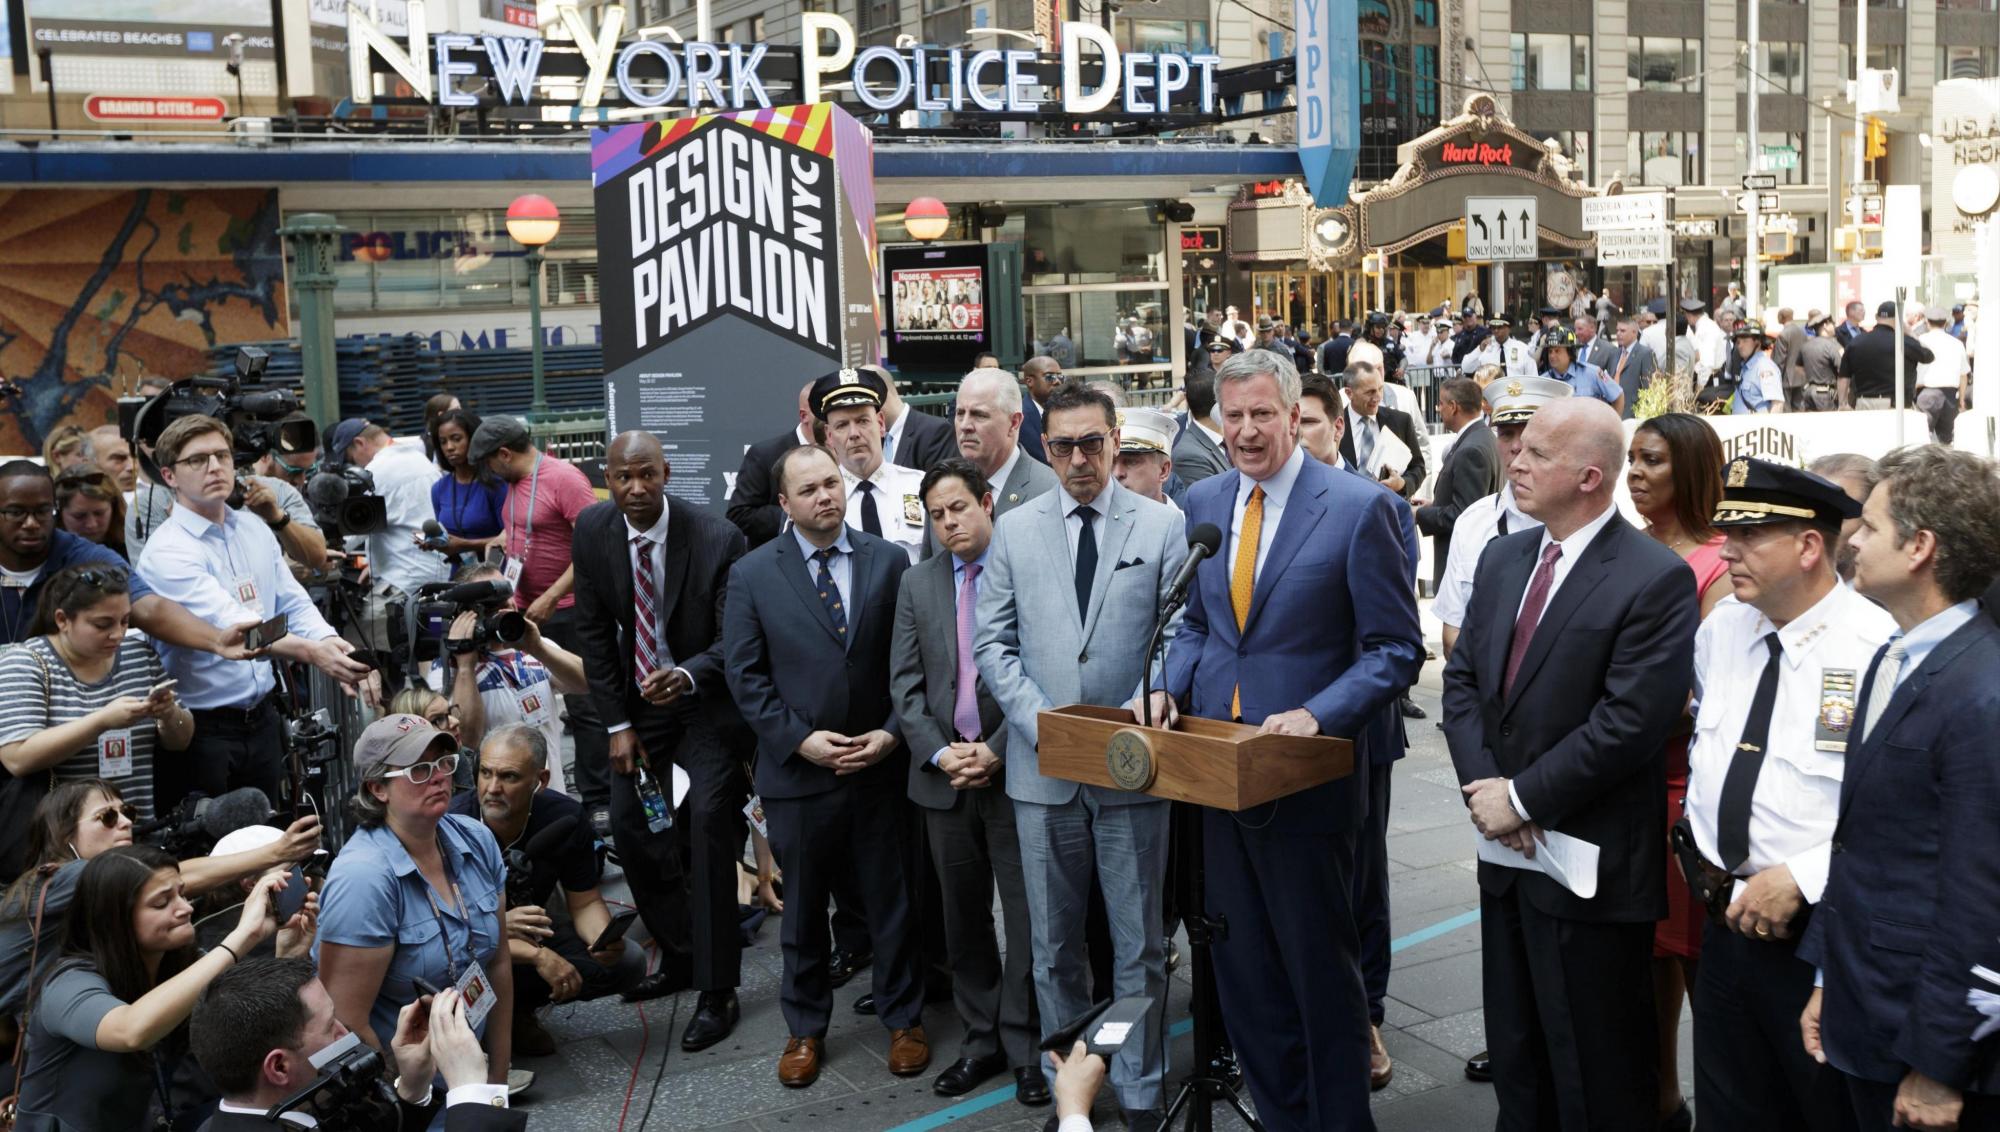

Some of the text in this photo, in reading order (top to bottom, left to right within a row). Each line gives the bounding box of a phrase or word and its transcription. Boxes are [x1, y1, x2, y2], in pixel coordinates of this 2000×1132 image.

[35, 28, 122, 44] CELEBRATED
[123, 31, 183, 46] BEACHES
[348, 0, 1222, 114] NEW YORK POLICE DEPT
[98, 100, 155, 115] BRANDED
[1442, 143, 1513, 166] Hard Rock
[629, 127, 785, 260] DESIGN
[790, 153, 824, 251] NYC
[1181, 231, 1204, 250] ock
[1469, 243, 1534, 255] ONLY ONLY ONLY
[1601, 234, 1632, 247] PEDESTRIAN
[632, 220, 829, 350] PAVILION
